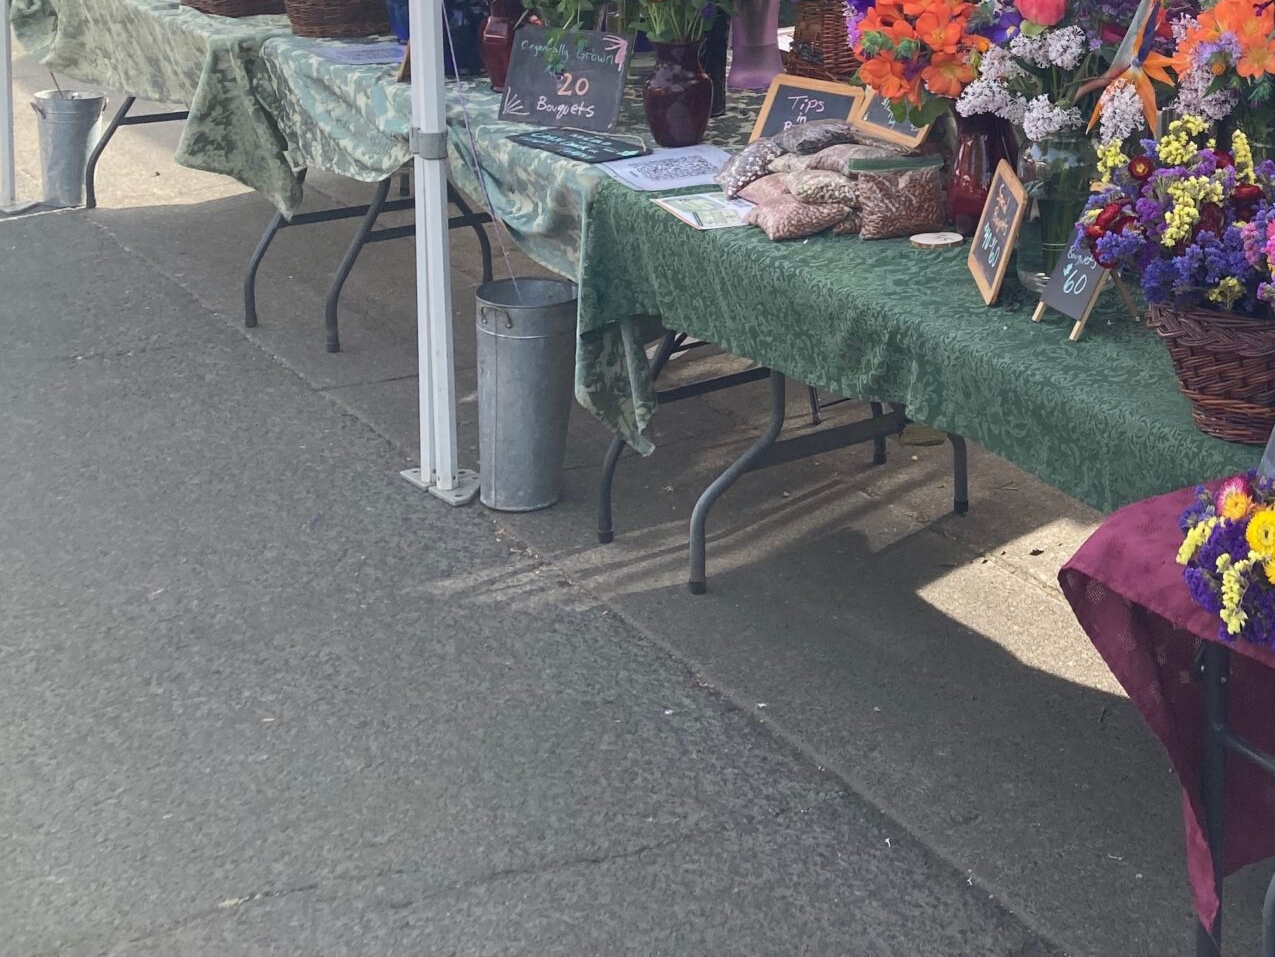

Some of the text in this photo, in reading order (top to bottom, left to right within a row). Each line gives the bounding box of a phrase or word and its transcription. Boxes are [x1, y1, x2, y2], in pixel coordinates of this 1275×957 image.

[576, 50, 614, 65] Grown
[536, 95, 596, 120] Bouquets
[787, 95, 825, 113] Tips
[796, 112, 807, 124] in
